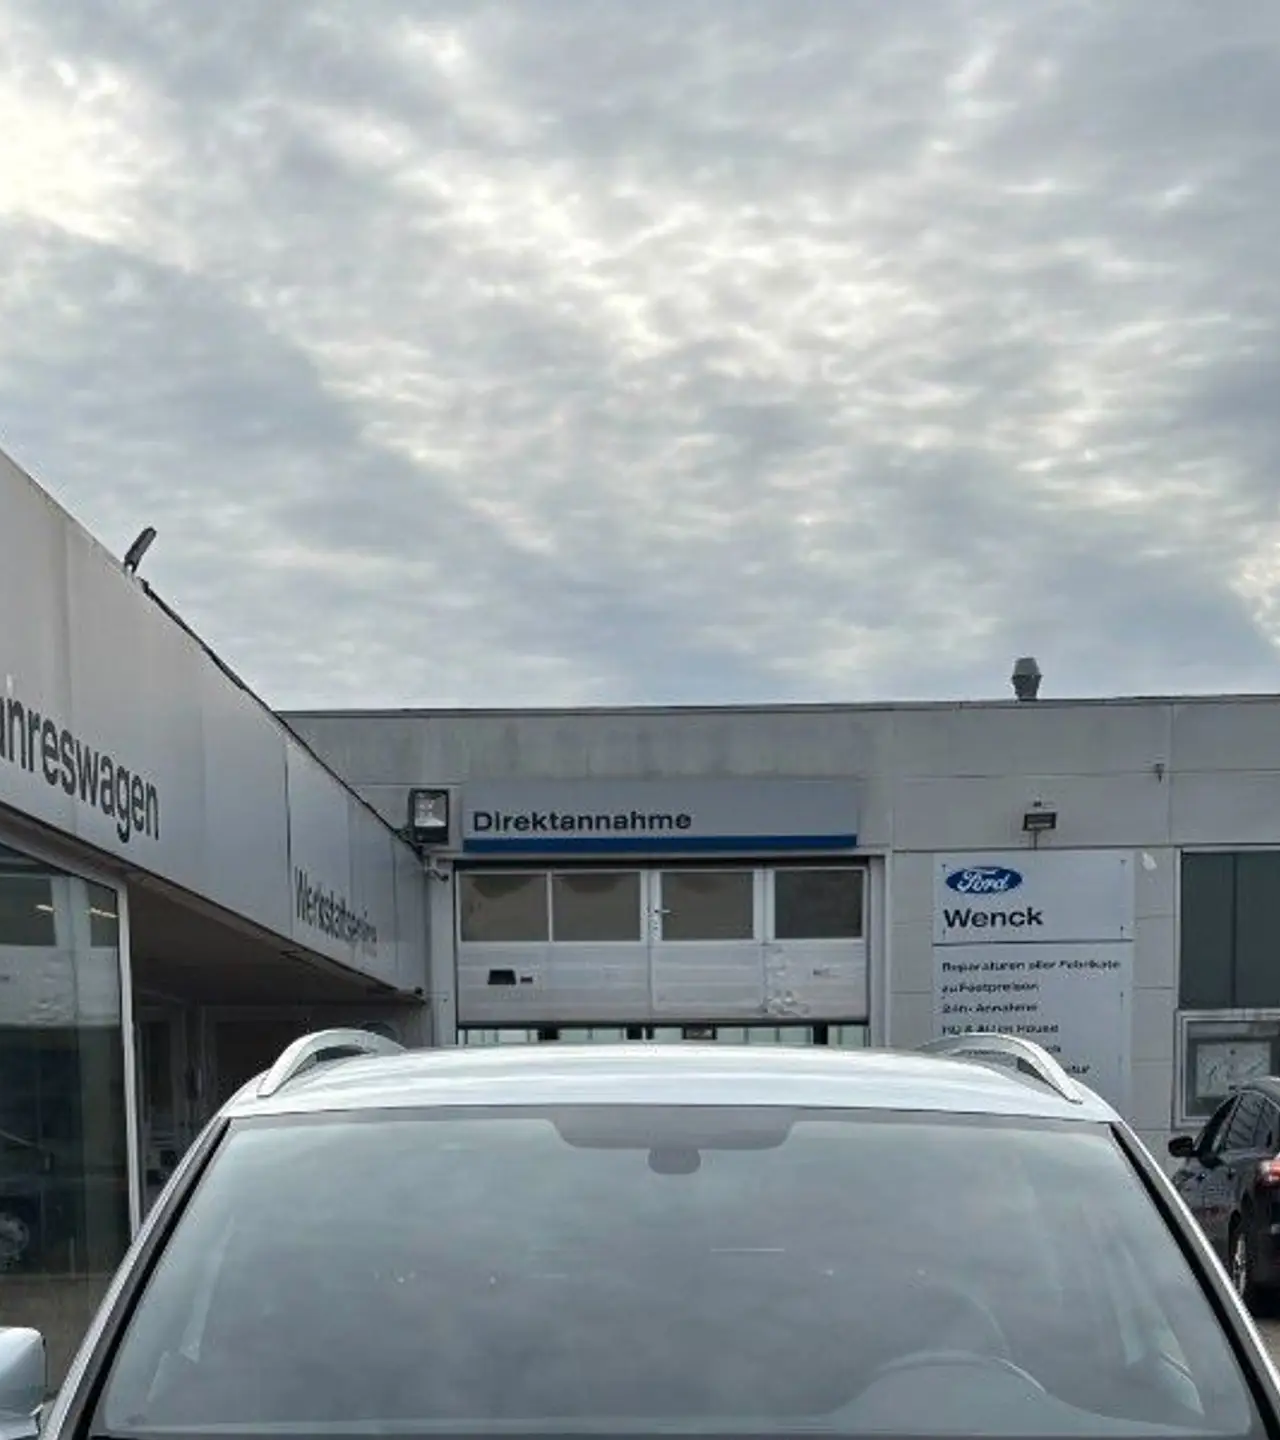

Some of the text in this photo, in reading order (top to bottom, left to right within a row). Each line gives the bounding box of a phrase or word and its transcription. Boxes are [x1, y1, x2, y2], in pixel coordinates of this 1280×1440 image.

[473, 810, 692, 832] Direktannahme
[952, 867, 1017, 893] Ford
[943, 907, 1045, 929] Wenck
